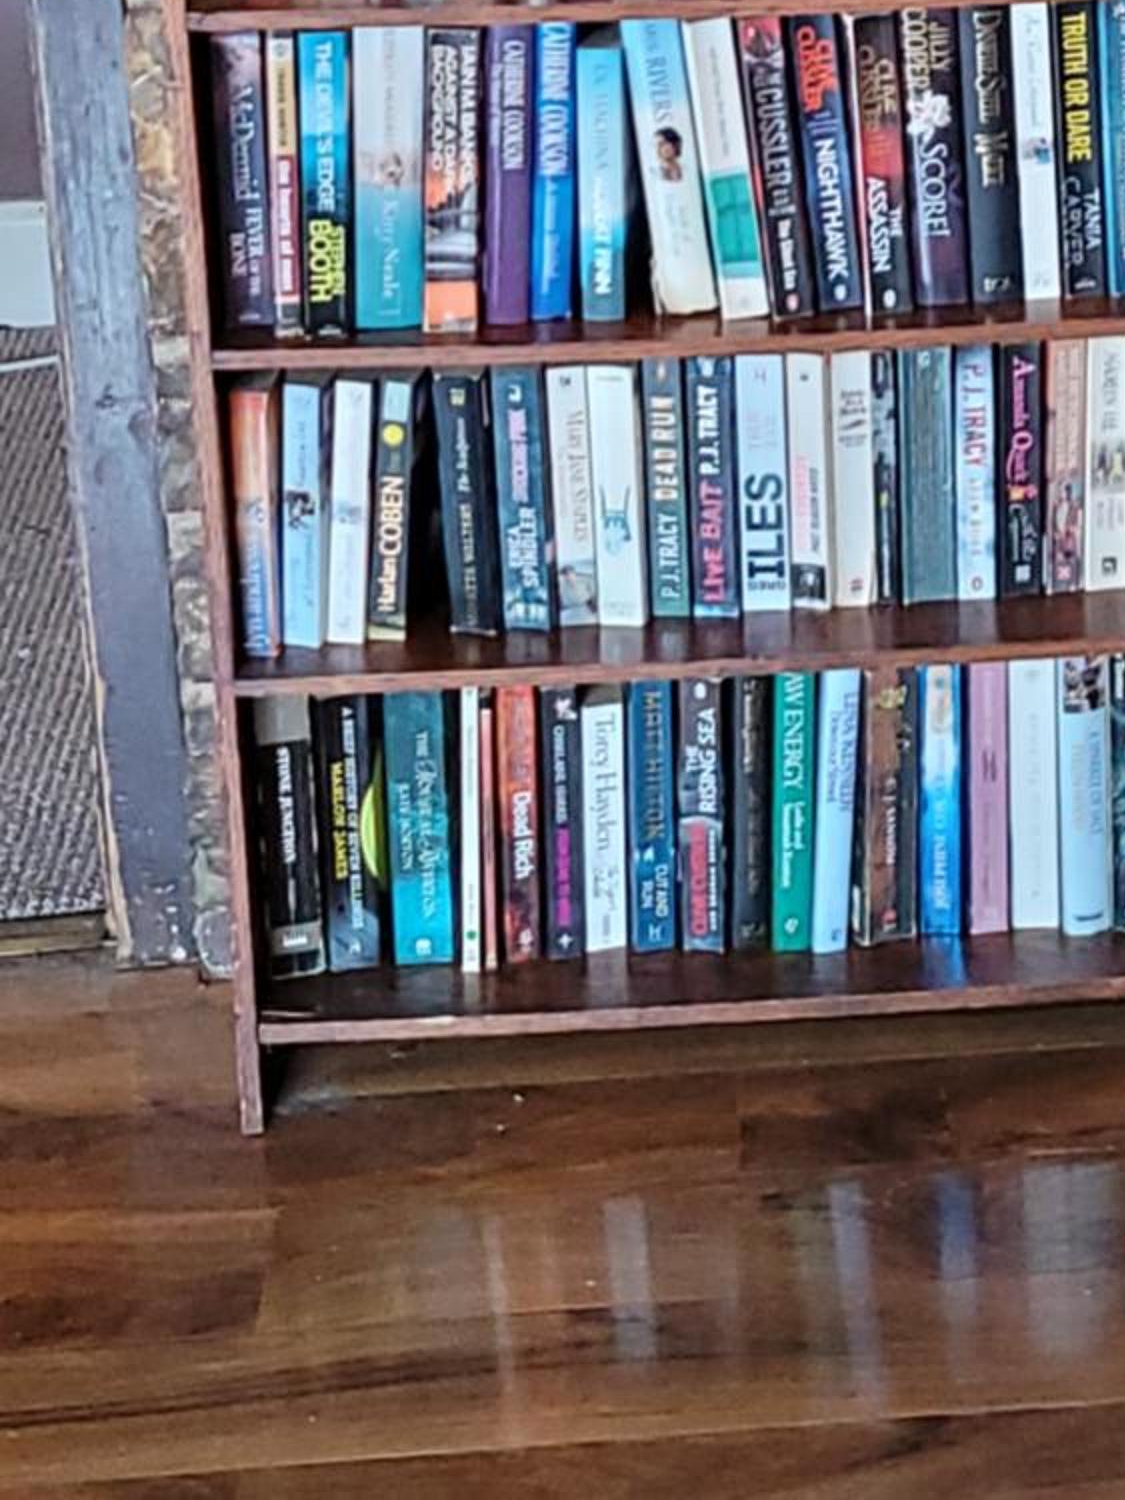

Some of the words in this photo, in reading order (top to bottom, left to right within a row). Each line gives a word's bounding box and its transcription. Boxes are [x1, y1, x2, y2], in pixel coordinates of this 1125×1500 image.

[314, 41, 333, 79] THE
[458, 45, 477, 88] IAIN
[540, 22, 569, 101] CATHERINE
[796, 25, 823, 113] CUSSLER
[902, 8, 931, 88] COOPER
[926, 22, 953, 71] JILLY
[1061, 11, 1087, 73] TRUTH
[443, 45, 459, 127] AGAINST
[502, 40, 525, 106] CATHERINE
[647, 56, 679, 123] RIVERS
[859, 44, 884, 134] CUSSLER
[877, 58, 898, 114] CLIVE
[1063, 77, 1086, 106] OR
[316, 84, 335, 153] DEVIL'S
[428, 45, 446, 172] BACKGROUND
[751, 88, 793, 185] CUSSLER
[460, 112, 478, 185] BANKS
[502, 109, 525, 171] COOKSON
[540, 104, 568, 177] COOKSON
[1064, 110, 1092, 164] DARE
[317, 157, 335, 213] EDGE
[445, 144, 461, 200] DARK
[919, 142, 951, 237] SCORE!
[245, 206, 265, 256] FEVER
[815, 138, 849, 281] NIGHTHAWK
[867, 176, 891, 273] ASSASSIN
[887, 206, 904, 236] THE
[1064, 176, 1085, 266] CARVER
[1082, 189, 1102, 250] TANIA
[231, 232, 248, 276] BONE
[308, 219, 334, 302] BOOTH
[383, 246, 400, 298] Neale
[594, 247, 613, 295] FINN
[651, 397, 675, 442] RUN
[698, 386, 720, 439] TRACY
[1013, 355, 1038, 429] Amanda
[962, 406, 988, 467] TRACY
[1006, 430, 1035, 483] Quick
[653, 449, 679, 501] DEAD
[378, 476, 404, 556] COBEN
[699, 481, 723, 541] BAIT
[745, 473, 784, 578] ILES
[658, 513, 679, 567] TRACY
[377, 558, 398, 613] Harlan
[702, 547, 725, 603] LIVE
[341, 707, 354, 717] A
[783, 674, 804, 705] AW
[644, 691, 663, 750] MATT
[695, 707, 717, 746] SEA
[685, 744, 702, 773] THE
[783, 709, 804, 789] ENERGY
[331, 762, 347, 826] MARLON
[345, 757, 359, 810] HISTORY
[695, 749, 718, 814] RISING
[278, 796, 297, 863] JUNCTION
[347, 813, 360, 829] OF
[512, 789, 534, 836] Dead
[591, 771, 619, 851] Hayden
[334, 830, 349, 880] JAMES
[513, 838, 537, 881] Rich
[654, 863, 668, 889] CUT
[640, 880, 655, 908] RUN
[654, 890, 668, 918] AND
